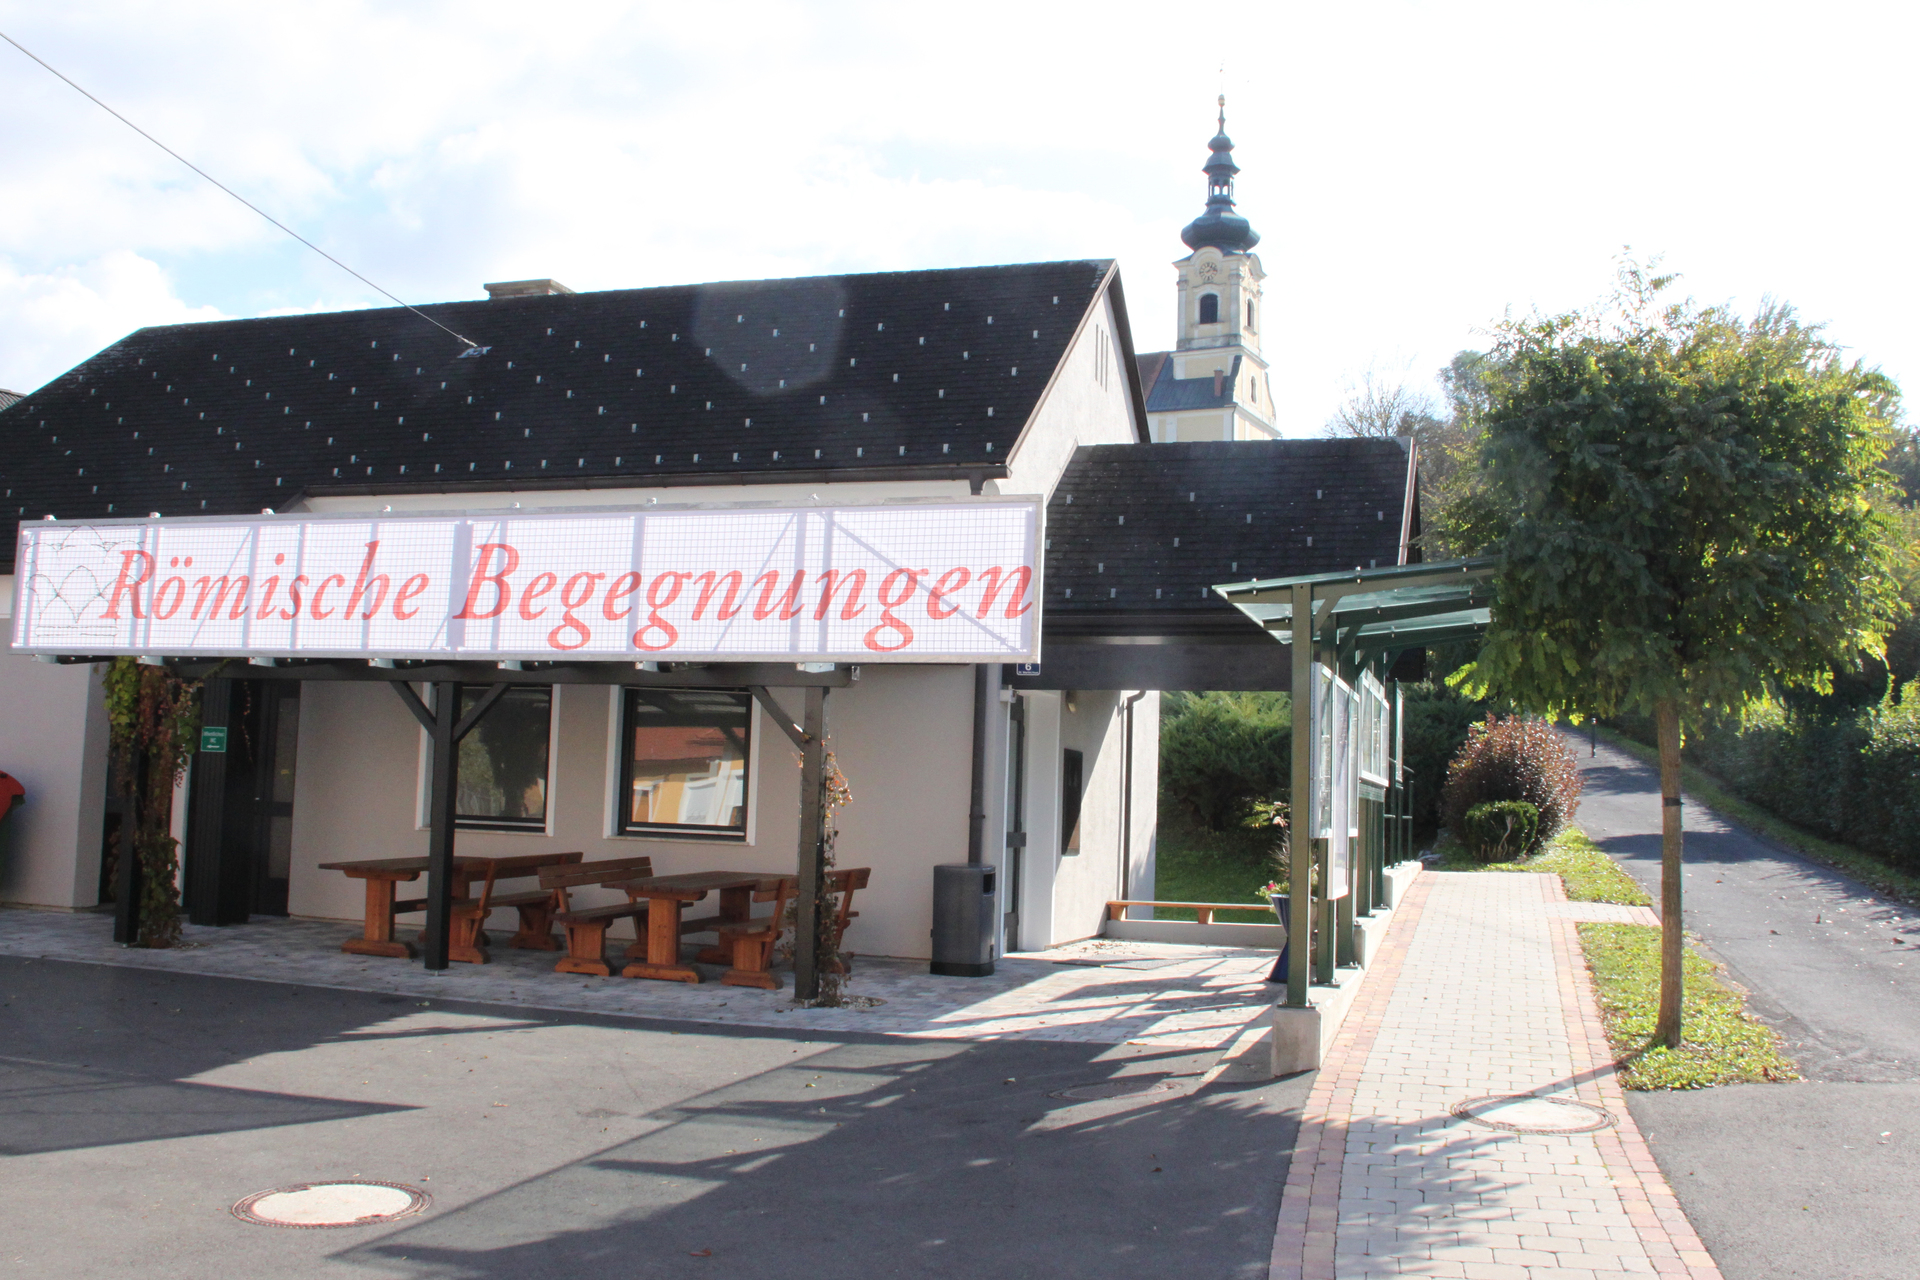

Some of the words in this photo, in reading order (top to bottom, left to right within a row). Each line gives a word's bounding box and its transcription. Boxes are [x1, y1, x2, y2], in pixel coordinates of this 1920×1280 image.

[99, 540, 430, 621] Römische
[452, 543, 1033, 653] Begegnungen
[1025, 662, 1032, 671] 6
